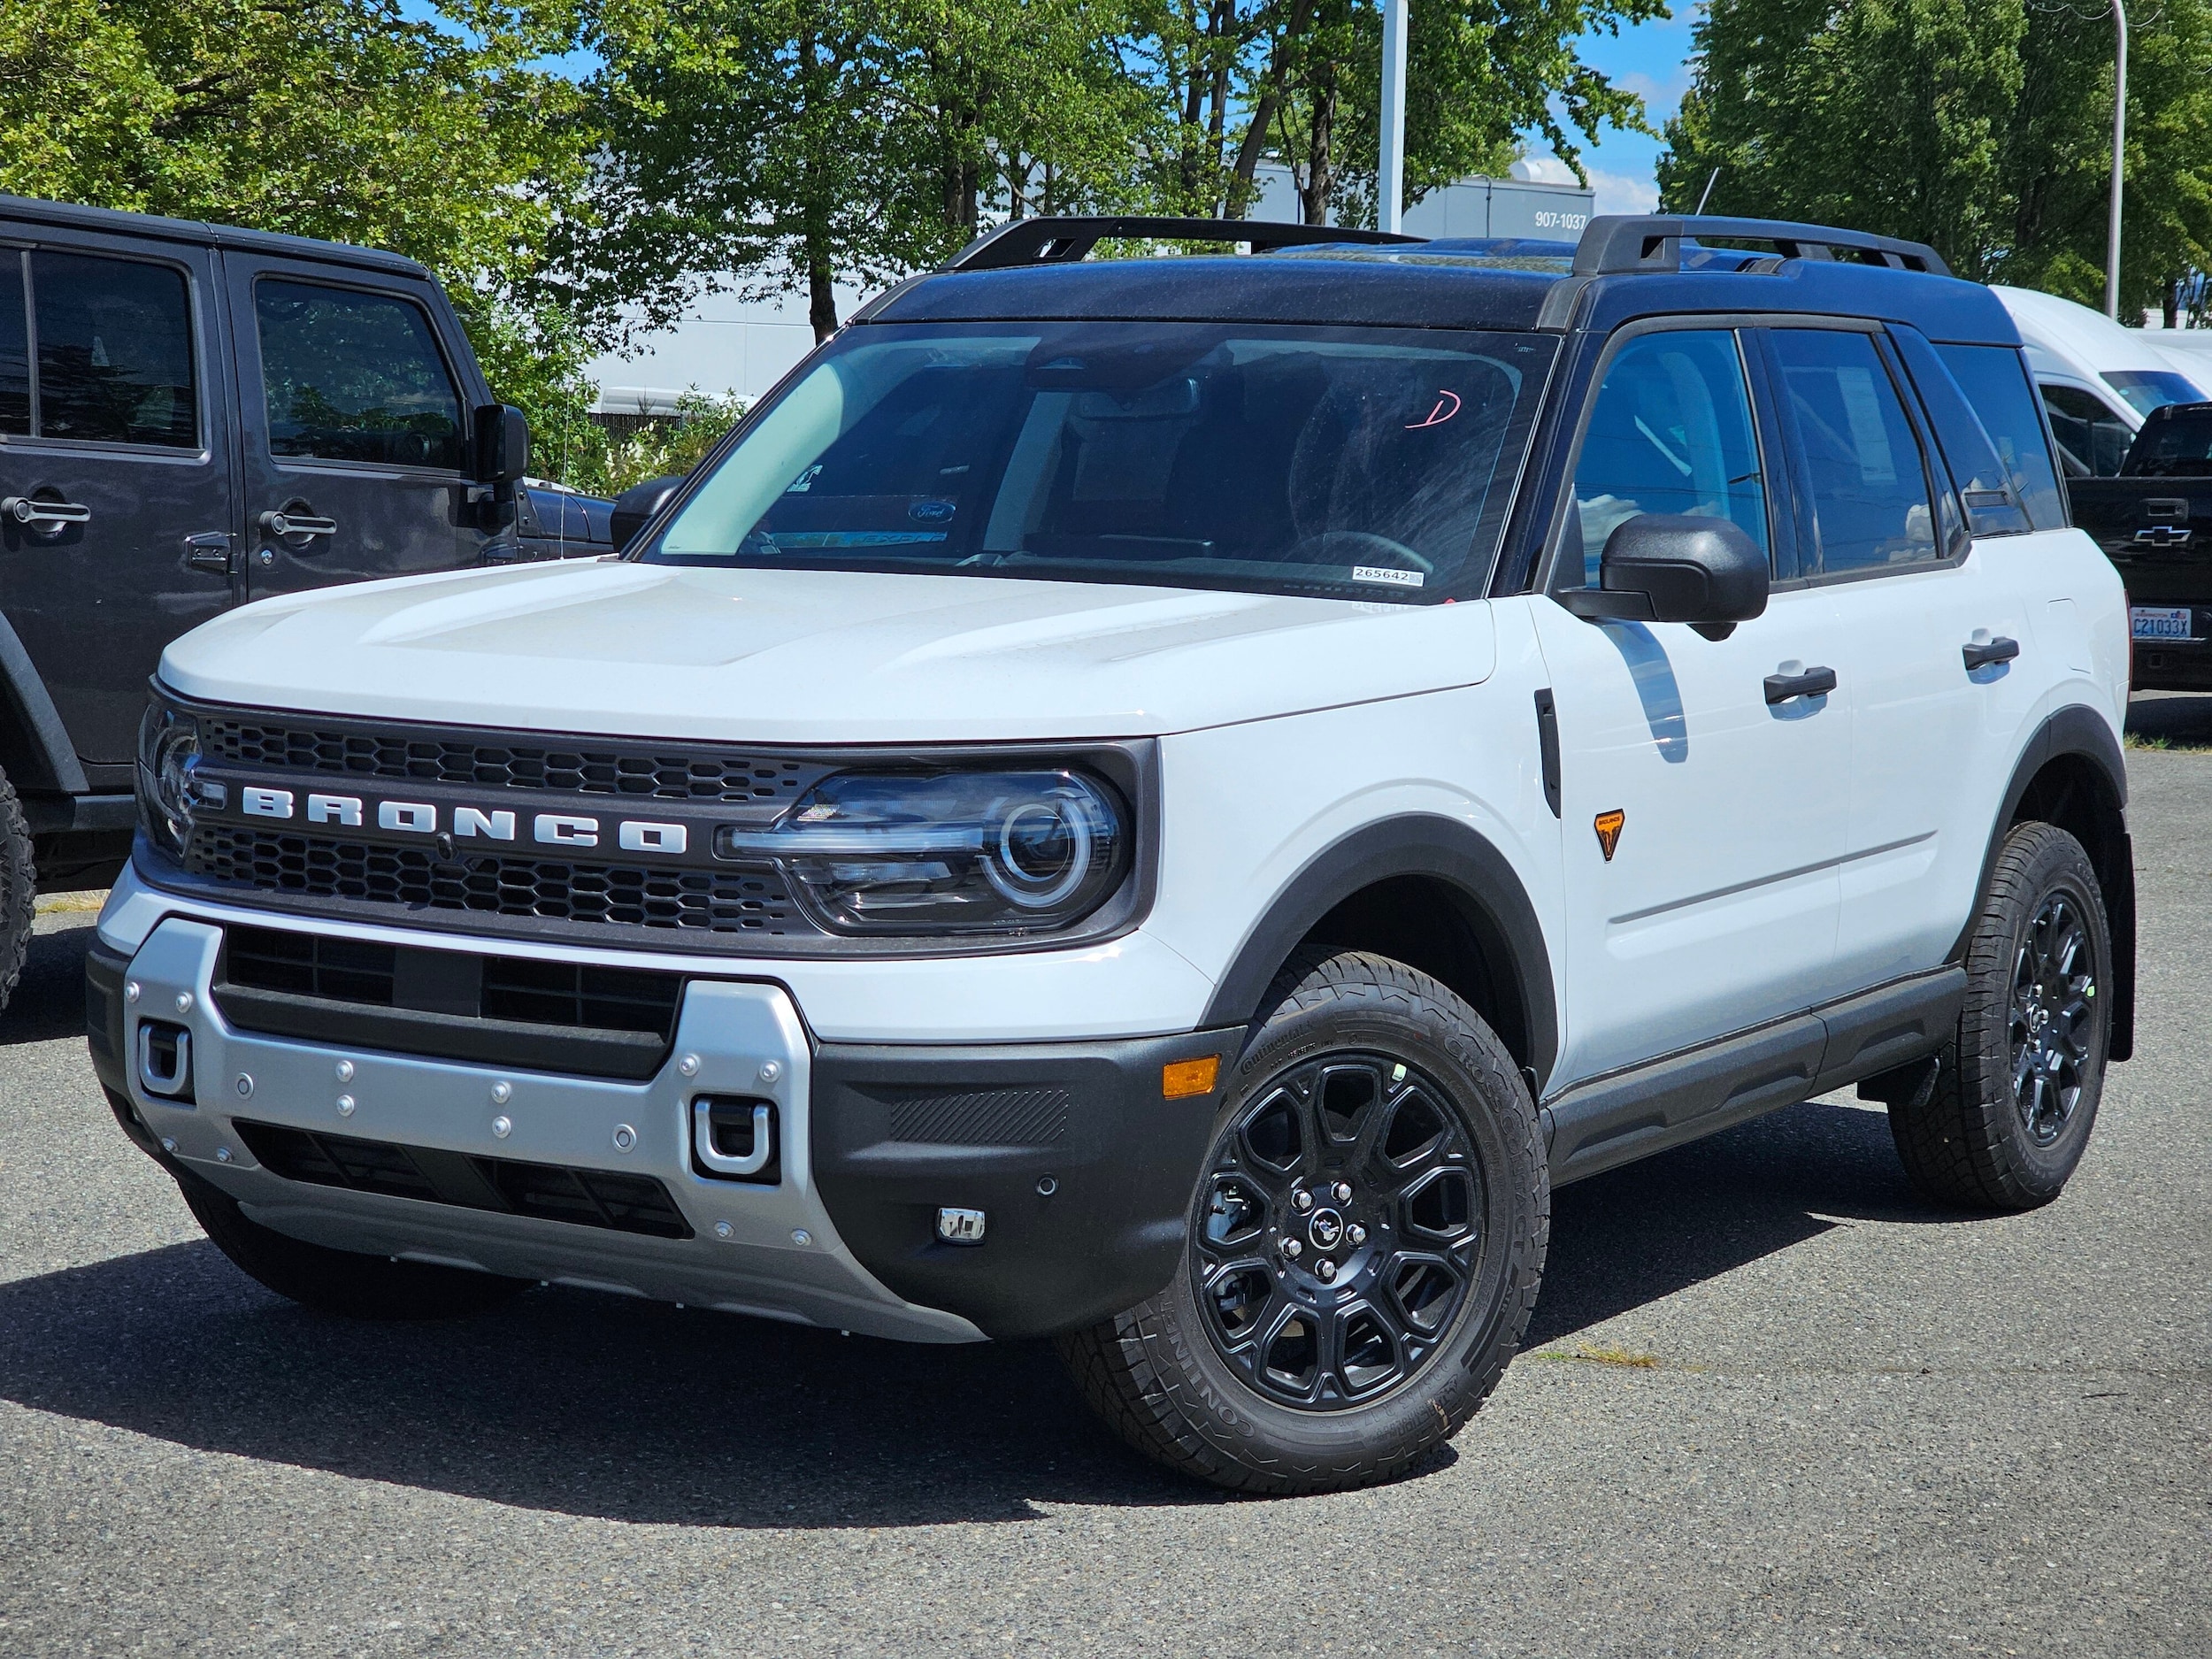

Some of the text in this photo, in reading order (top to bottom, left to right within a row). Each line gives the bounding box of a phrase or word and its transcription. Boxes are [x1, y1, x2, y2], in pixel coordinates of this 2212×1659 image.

[1535, 211, 1586, 230] 907-1037
[1404, 389, 1462, 429] D
[917, 504, 945, 518] Ford
[1355, 568, 1409, 581] 265642
[2133, 618, 2188, 635] C21033X
[242, 786, 688, 855] BRONCO
